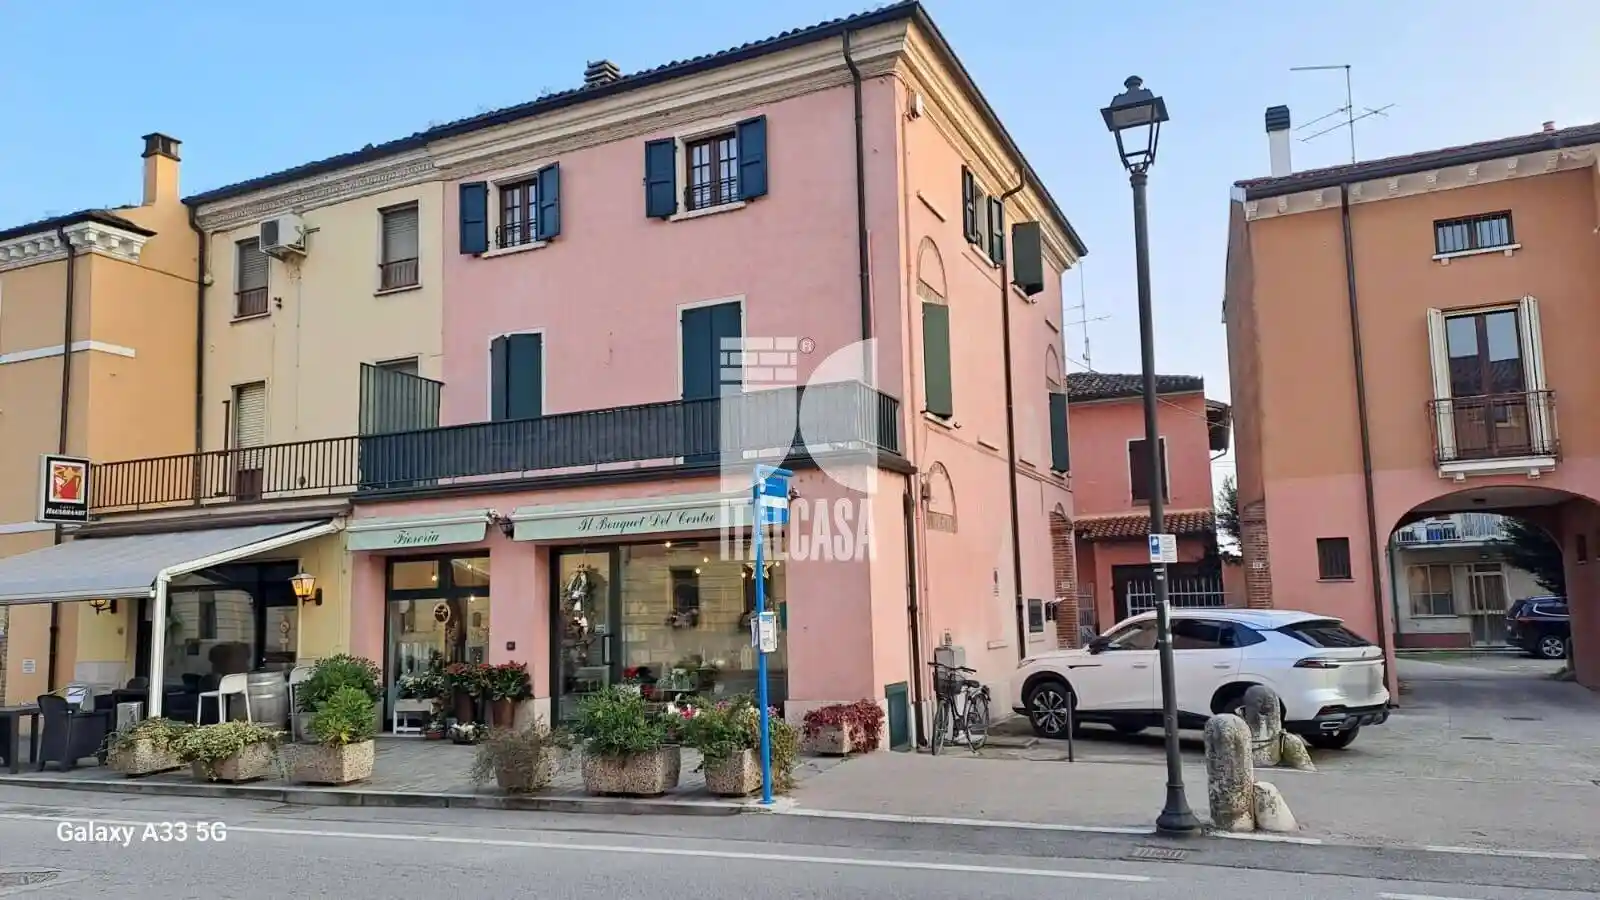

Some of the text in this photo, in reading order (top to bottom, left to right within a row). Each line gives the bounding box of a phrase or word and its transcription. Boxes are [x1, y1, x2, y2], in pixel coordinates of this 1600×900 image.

[577, 511, 717, 533] Il Bouquet Del Centro
